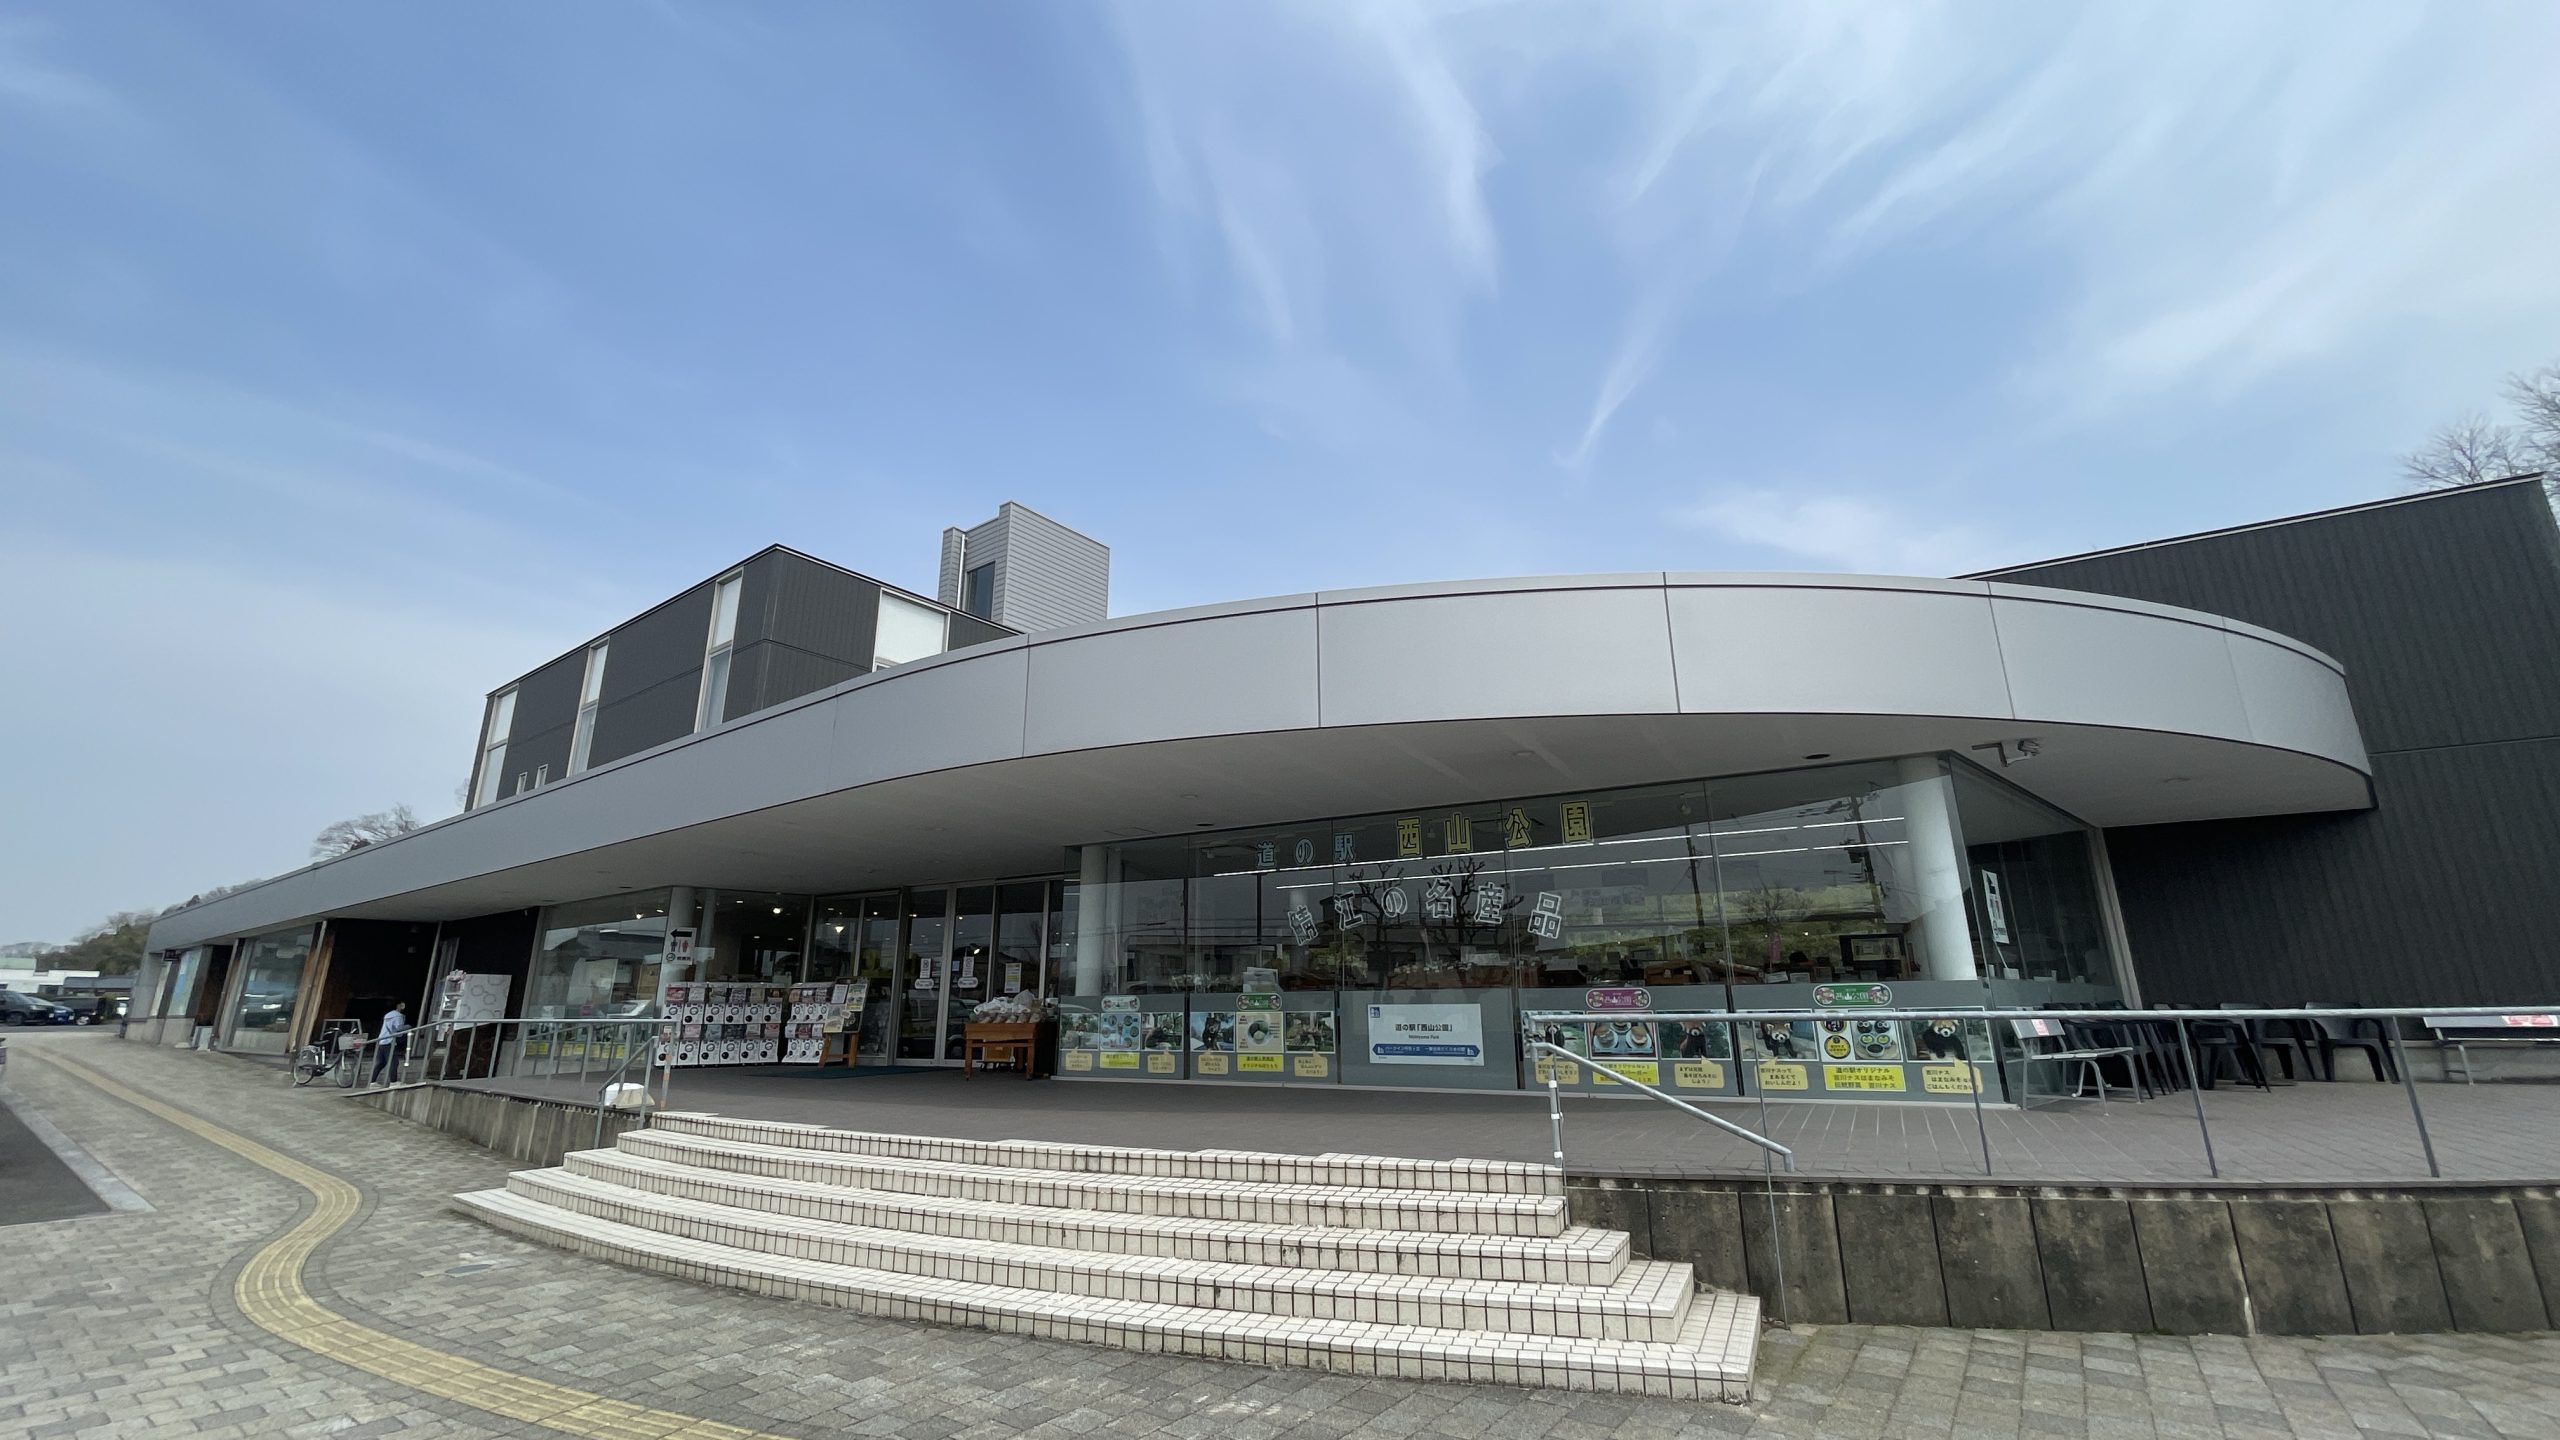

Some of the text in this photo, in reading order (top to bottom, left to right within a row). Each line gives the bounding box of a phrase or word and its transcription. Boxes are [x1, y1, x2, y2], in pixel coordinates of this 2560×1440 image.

[1256, 800, 1594, 868] 道の駅 西山公園
[1288, 879, 1562, 947] 鯖江の名産品
[1395, 1023, 1453, 1032] 道の駅「西山公園」
